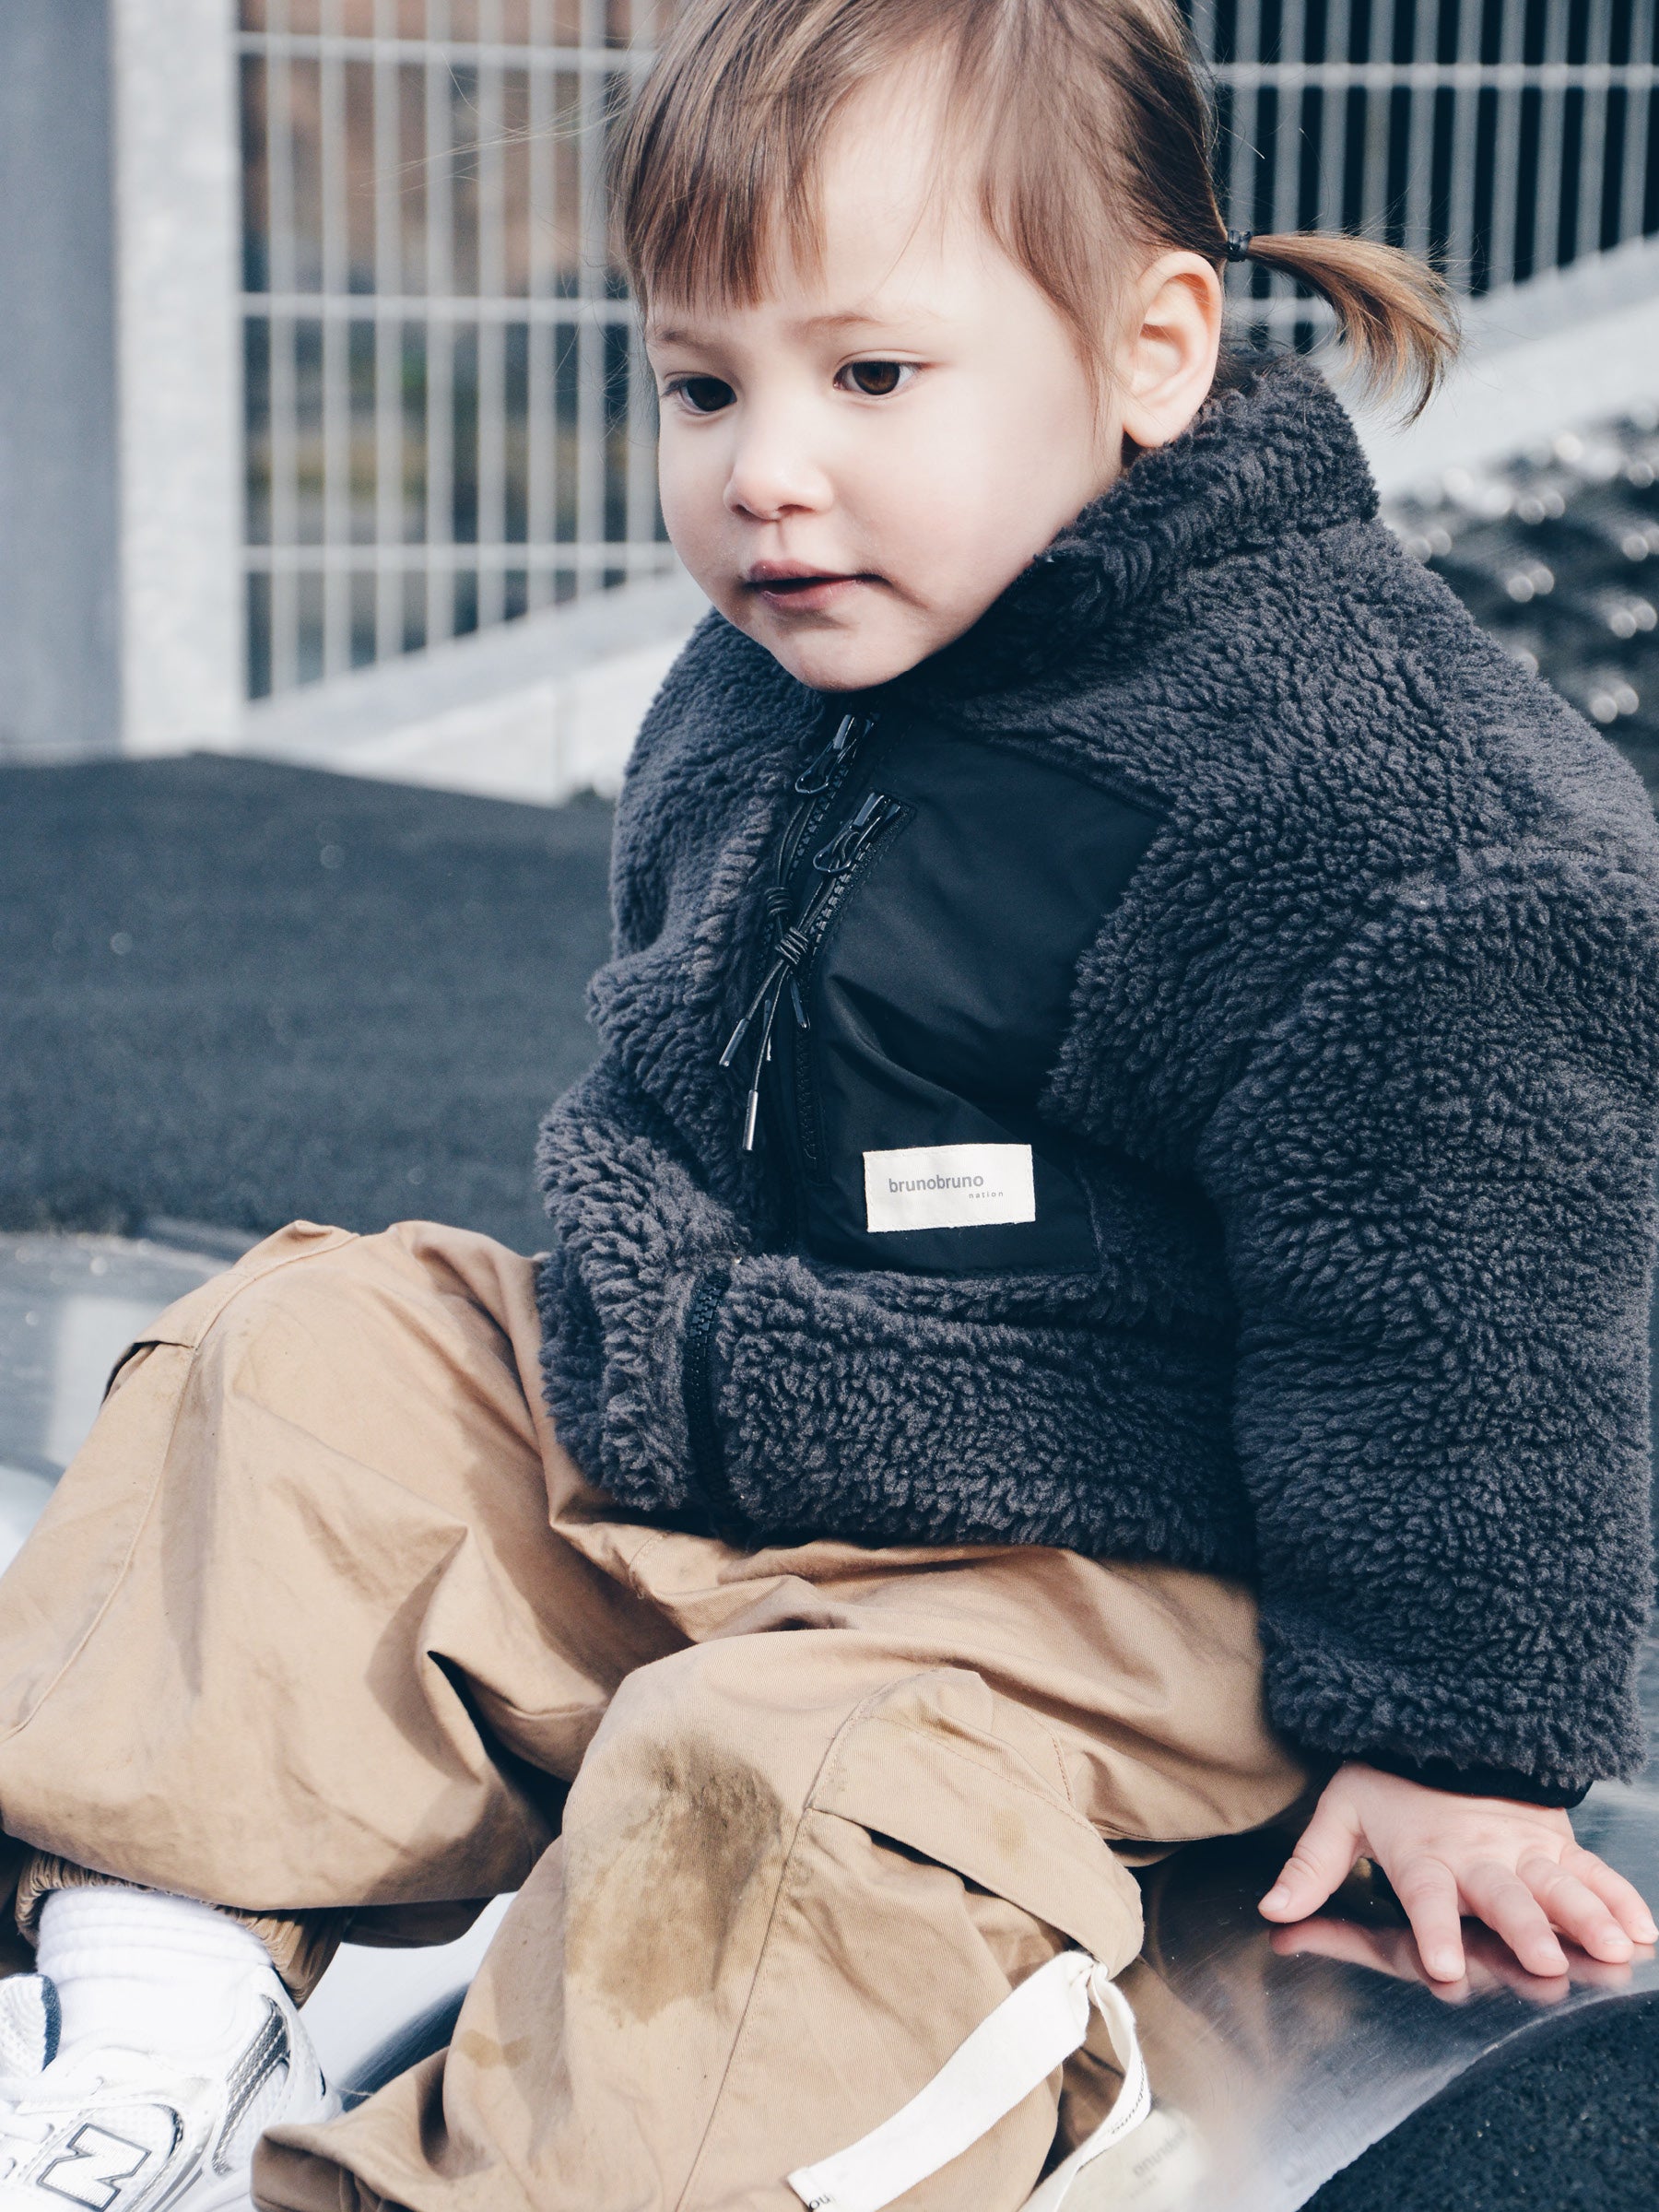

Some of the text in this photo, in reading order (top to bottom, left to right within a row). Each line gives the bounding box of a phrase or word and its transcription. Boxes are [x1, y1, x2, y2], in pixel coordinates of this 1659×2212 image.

[888, 1174, 984, 1193] brunobruno
[969, 1190, 1004, 1199] nation
[36, 2122, 152, 2212] N
